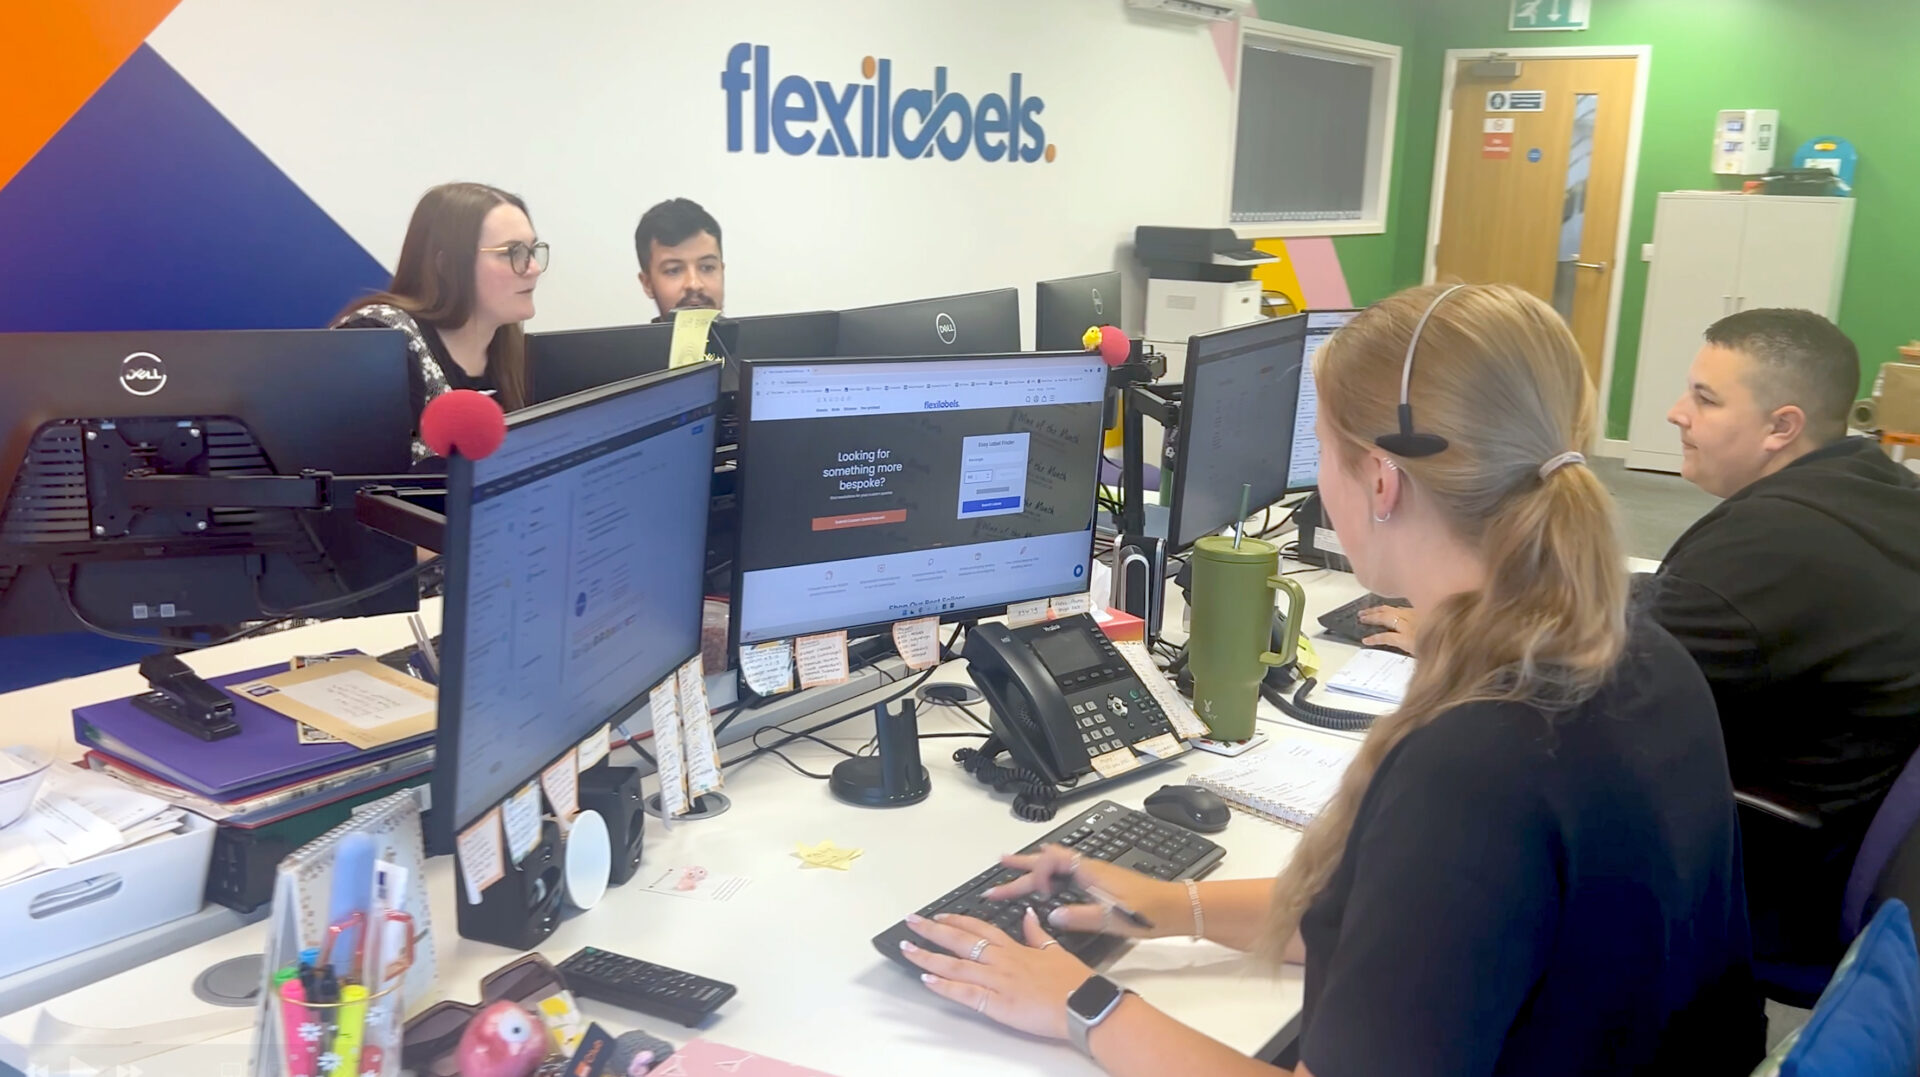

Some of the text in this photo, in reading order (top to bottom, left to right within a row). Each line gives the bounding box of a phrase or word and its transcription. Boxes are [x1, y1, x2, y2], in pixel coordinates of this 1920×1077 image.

[721, 42, 1057, 163] flexilabels.
[939, 324, 955, 333] DELL
[125, 368, 162, 380] DELL
[838, 448, 891, 463] Looking for
[823, 463, 903, 477] something more
[840, 477, 886, 492] bespoke?
